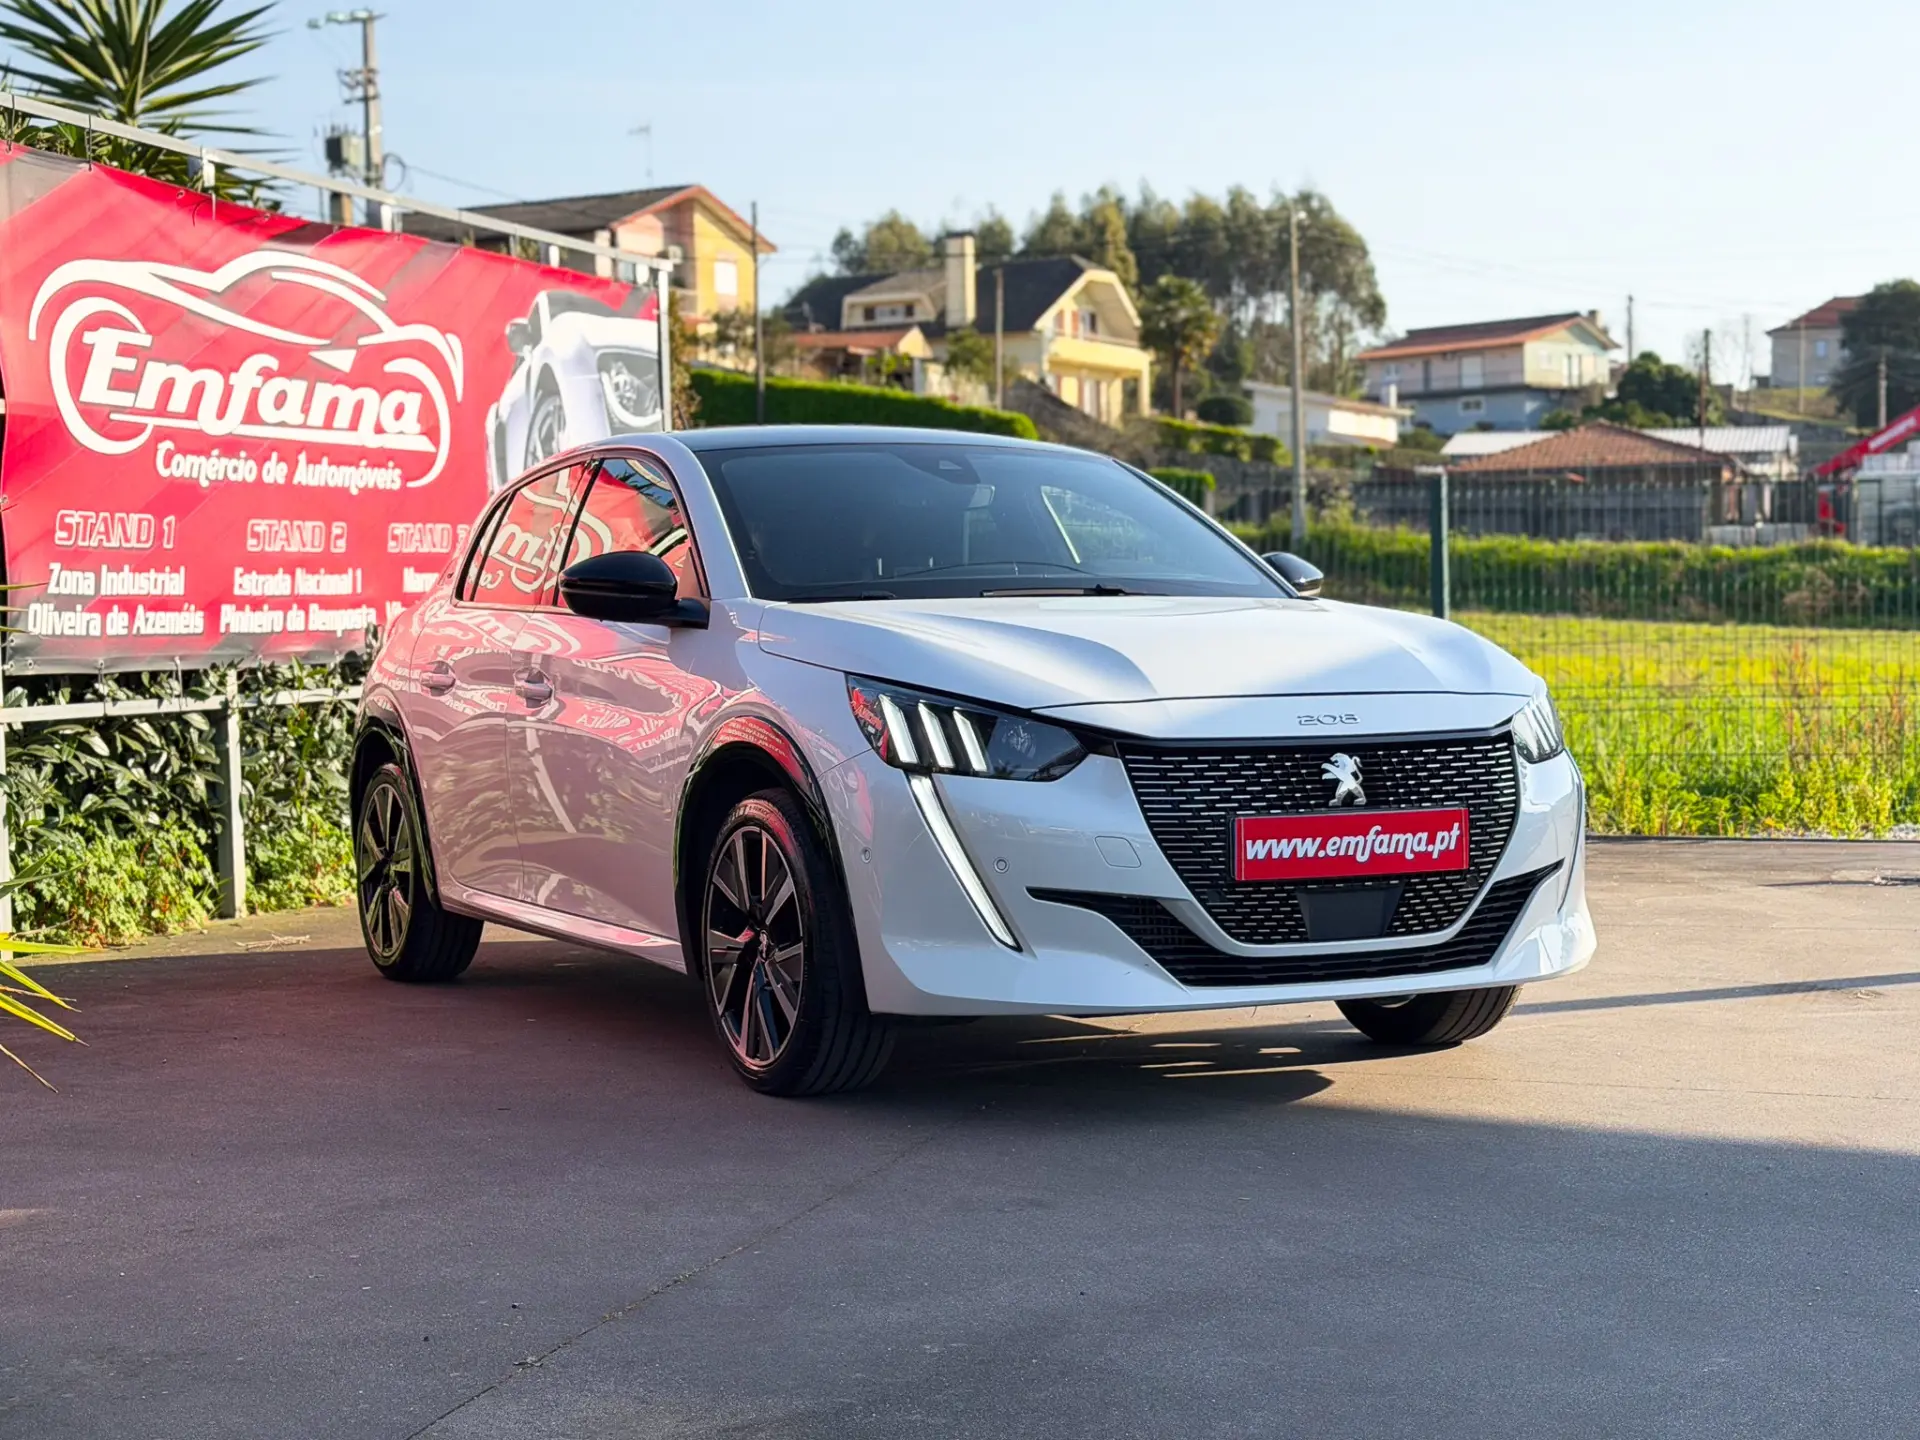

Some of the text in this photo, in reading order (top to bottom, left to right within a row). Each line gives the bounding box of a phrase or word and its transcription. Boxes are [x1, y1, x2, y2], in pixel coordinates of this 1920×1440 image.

[79, 326, 423, 448] Emfama
[155, 440, 403, 496] Comércio de Automóveis
[54, 509, 176, 549] STAND 1
[246, 519, 348, 554] STAND 2
[387, 522, 453, 553] STAND
[47, 562, 186, 596] Zona Industrial
[233, 567, 363, 596] Estrada Nacional 1
[27, 602, 205, 637] Oliveira de Azeméis
[219, 603, 285, 634] Pinheiro
[286, 603, 306, 632] da
[1296, 713, 1362, 727] 208
[1245, 821, 1461, 863] www.emfama.pt
